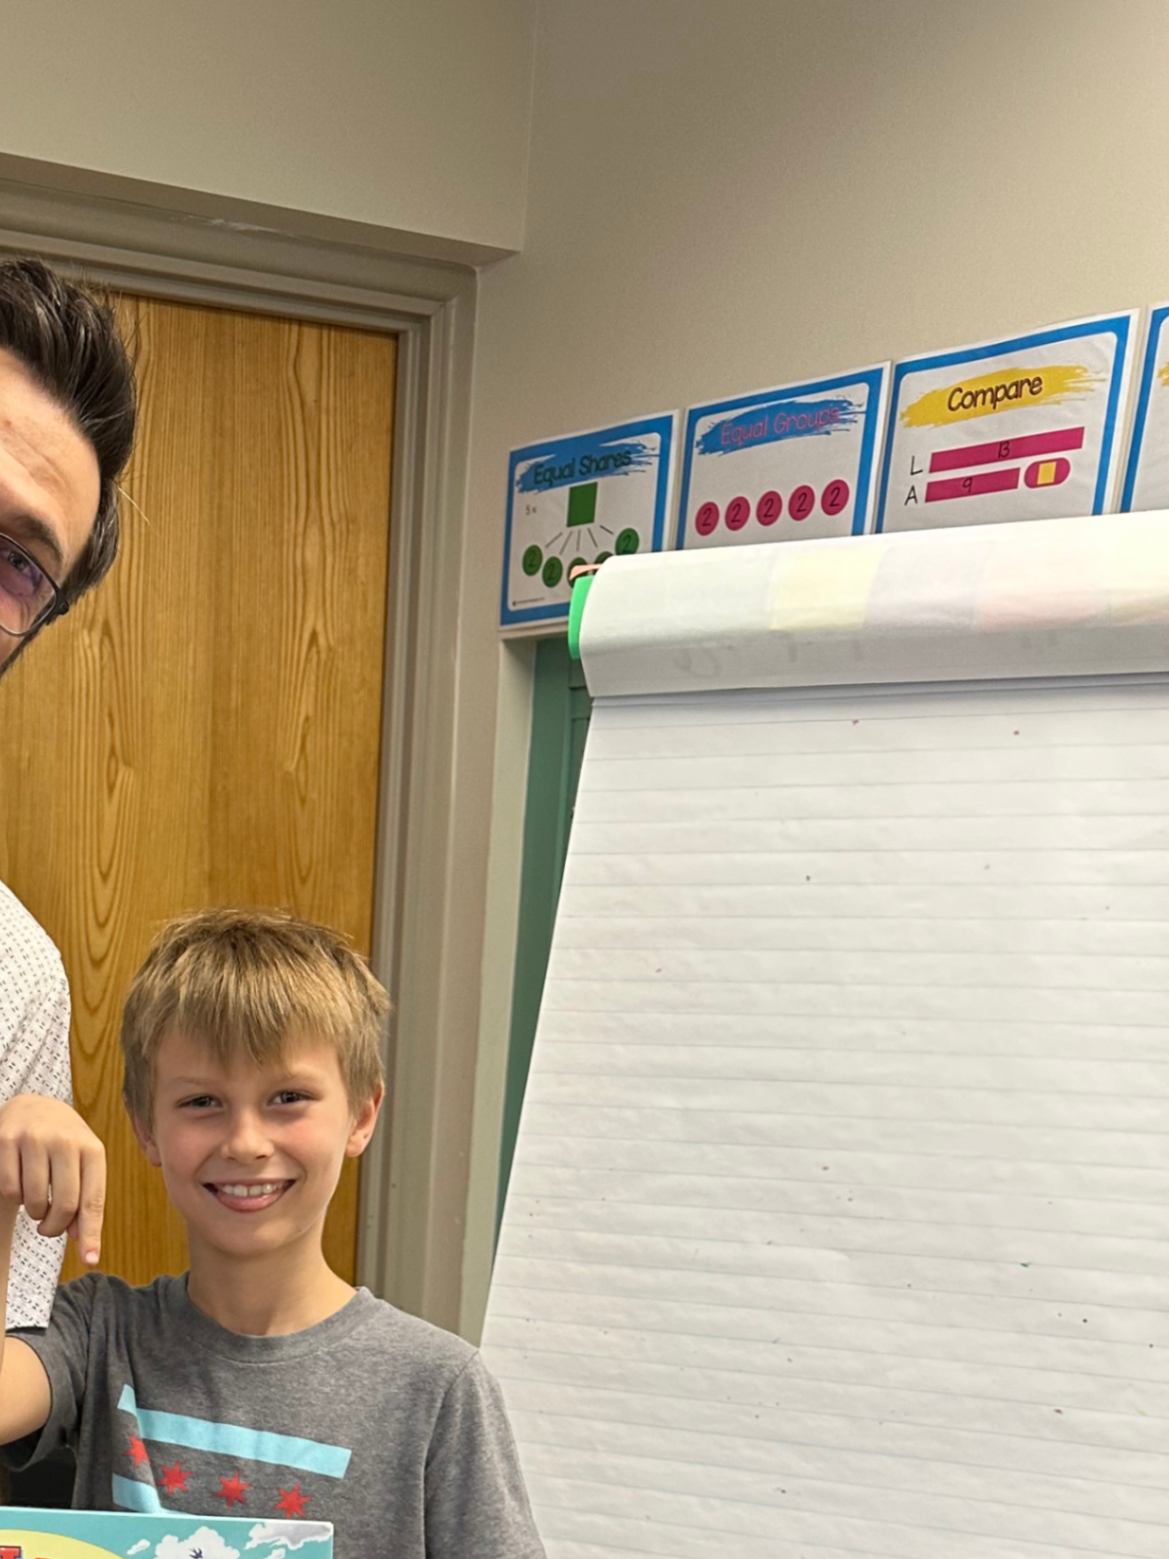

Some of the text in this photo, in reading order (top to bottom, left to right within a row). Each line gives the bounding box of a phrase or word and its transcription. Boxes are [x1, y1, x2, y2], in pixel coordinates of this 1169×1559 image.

[947, 376, 1044, 411] Compare
[720, 405, 842, 446] Equal Groups
[534, 450, 632, 486] Equal Shares
[909, 455, 923, 475] L
[904, 485, 919, 506] A
[962, 477, 973, 494] 9
[702, 486, 841, 527] 2 2 2 2 2
